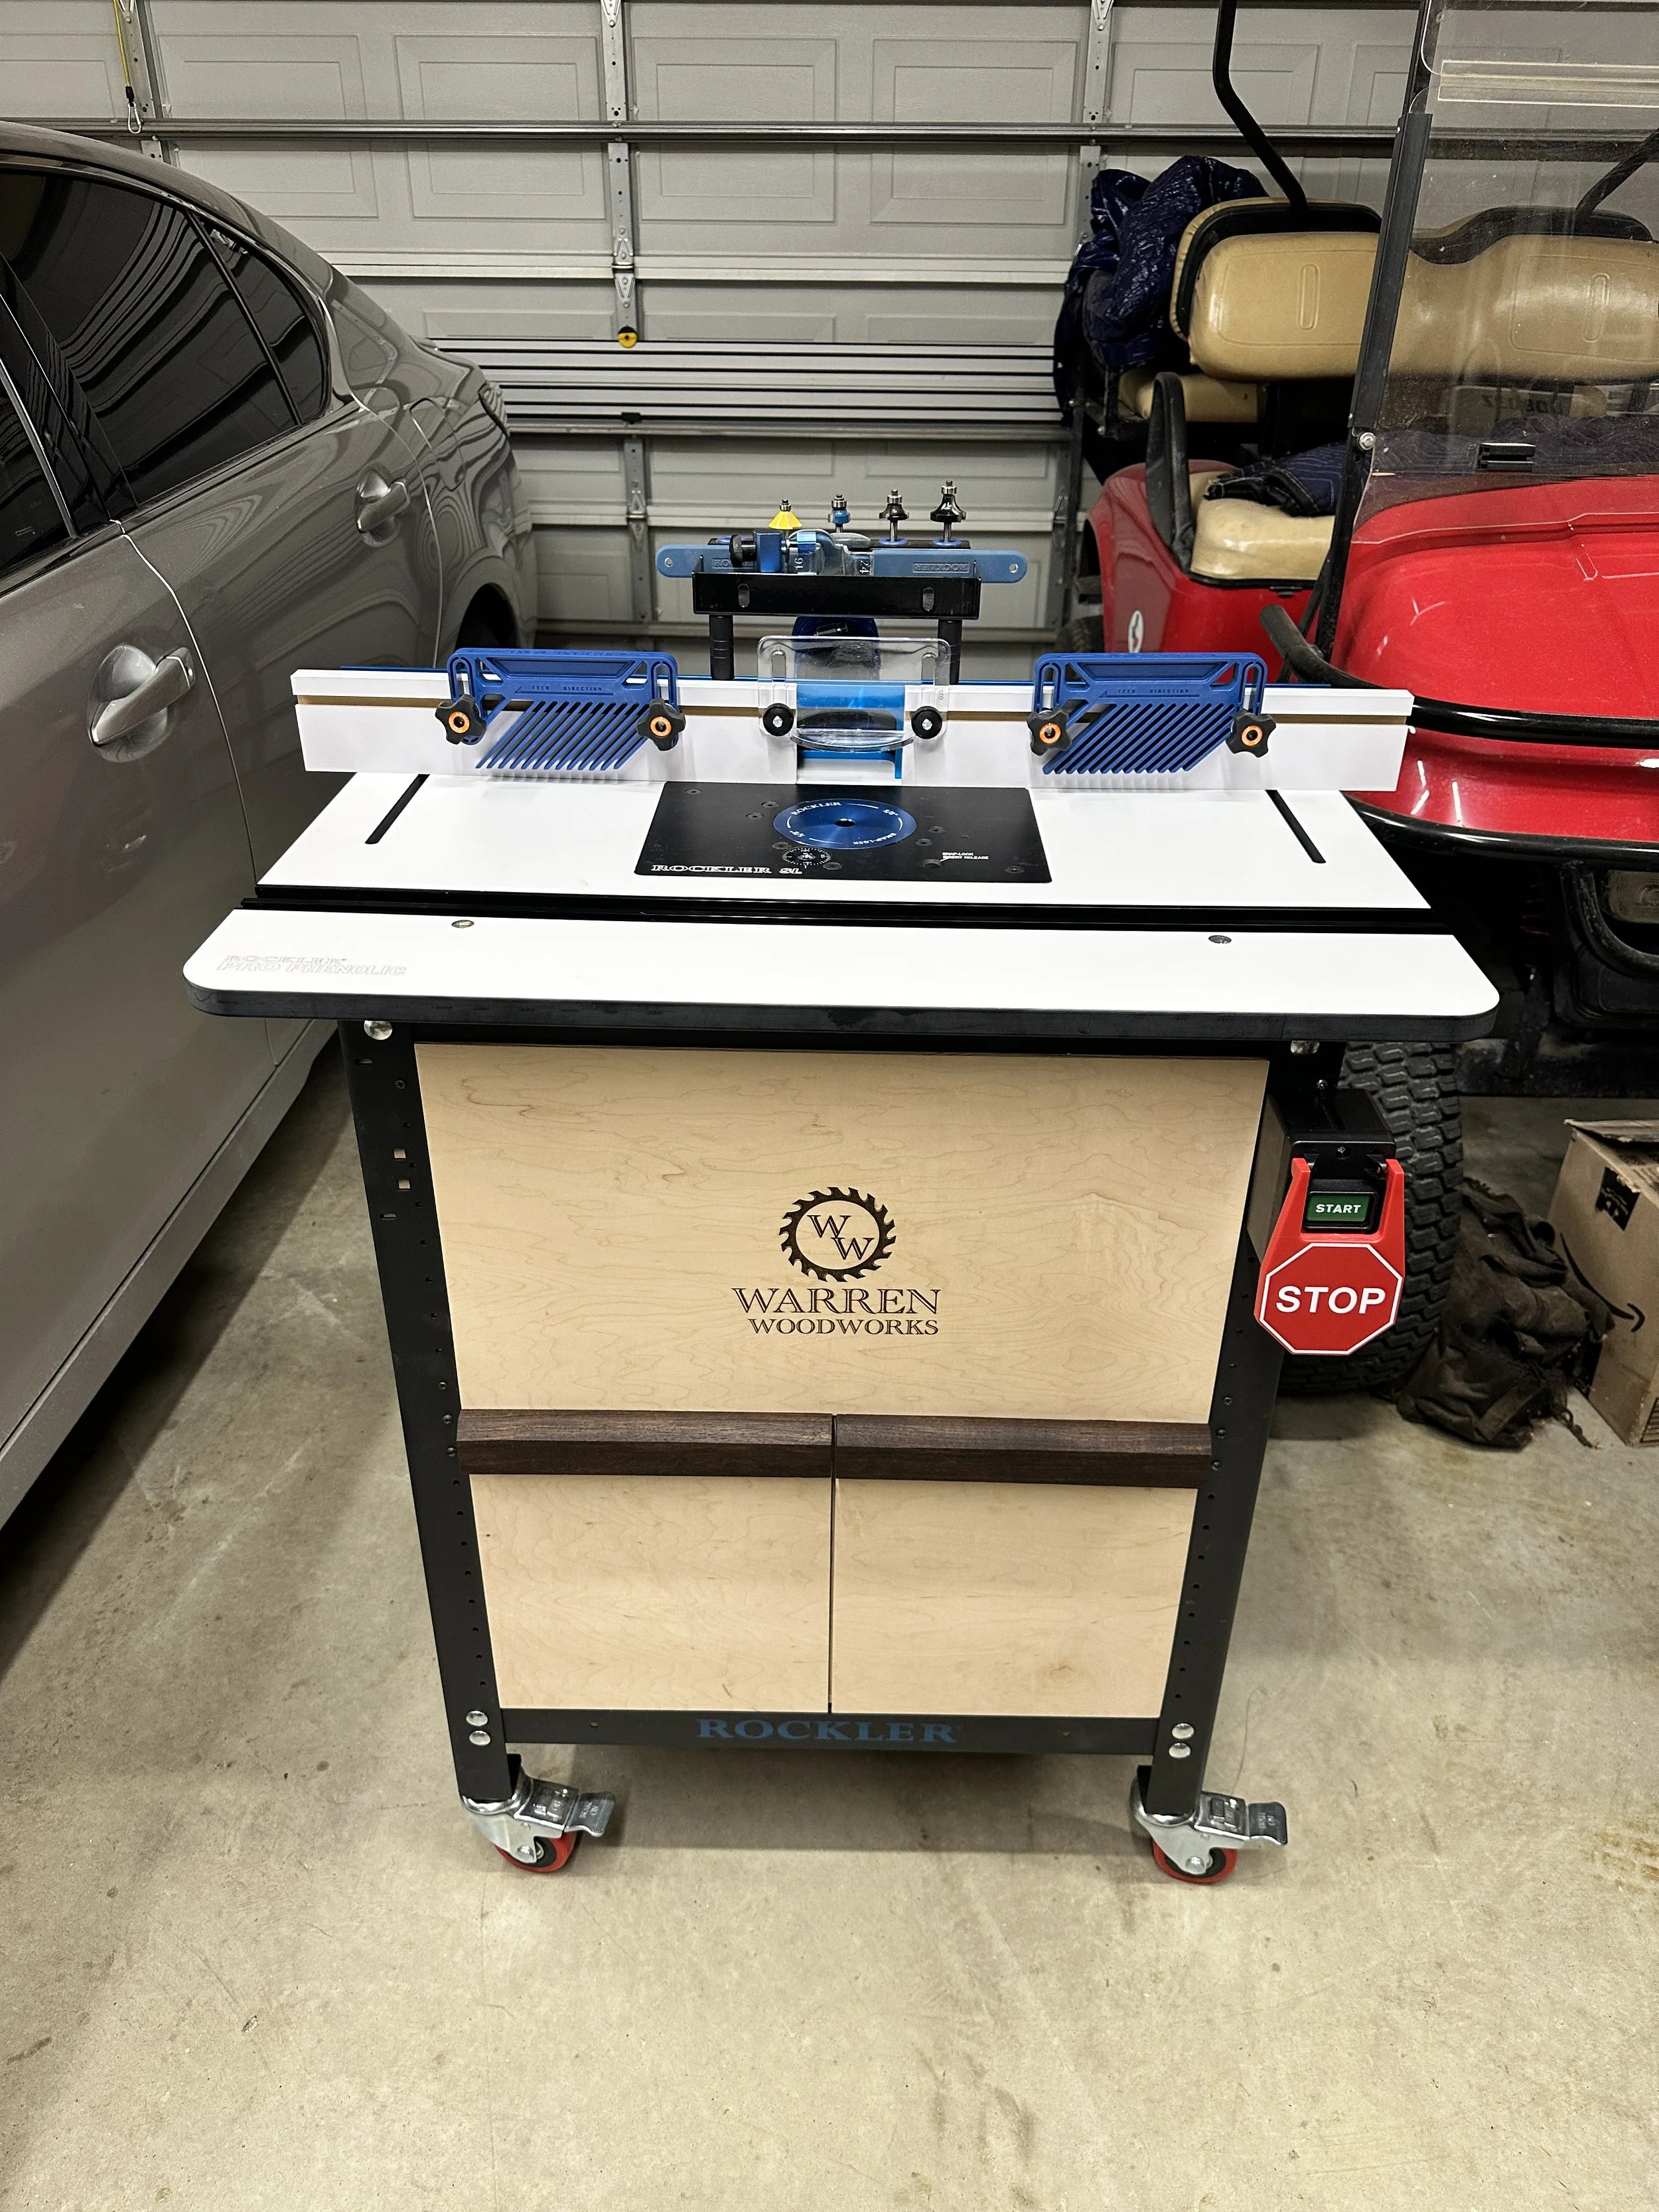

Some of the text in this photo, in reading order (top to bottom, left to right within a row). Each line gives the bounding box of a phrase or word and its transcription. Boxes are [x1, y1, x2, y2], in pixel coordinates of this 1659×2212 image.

[791, 802, 841, 816] ROCKLER
[650, 865, 772, 874] ROCKLER
[216, 962, 407, 976] PRO PHENOLIC
[1315, 1203, 1362, 1214] START
[731, 1288, 942, 1315] WARREN
[1275, 1286, 1386, 1314] STOP
[747, 1319, 939, 1336] WOODWORKS
[697, 1718, 956, 1742] ROCKLER
